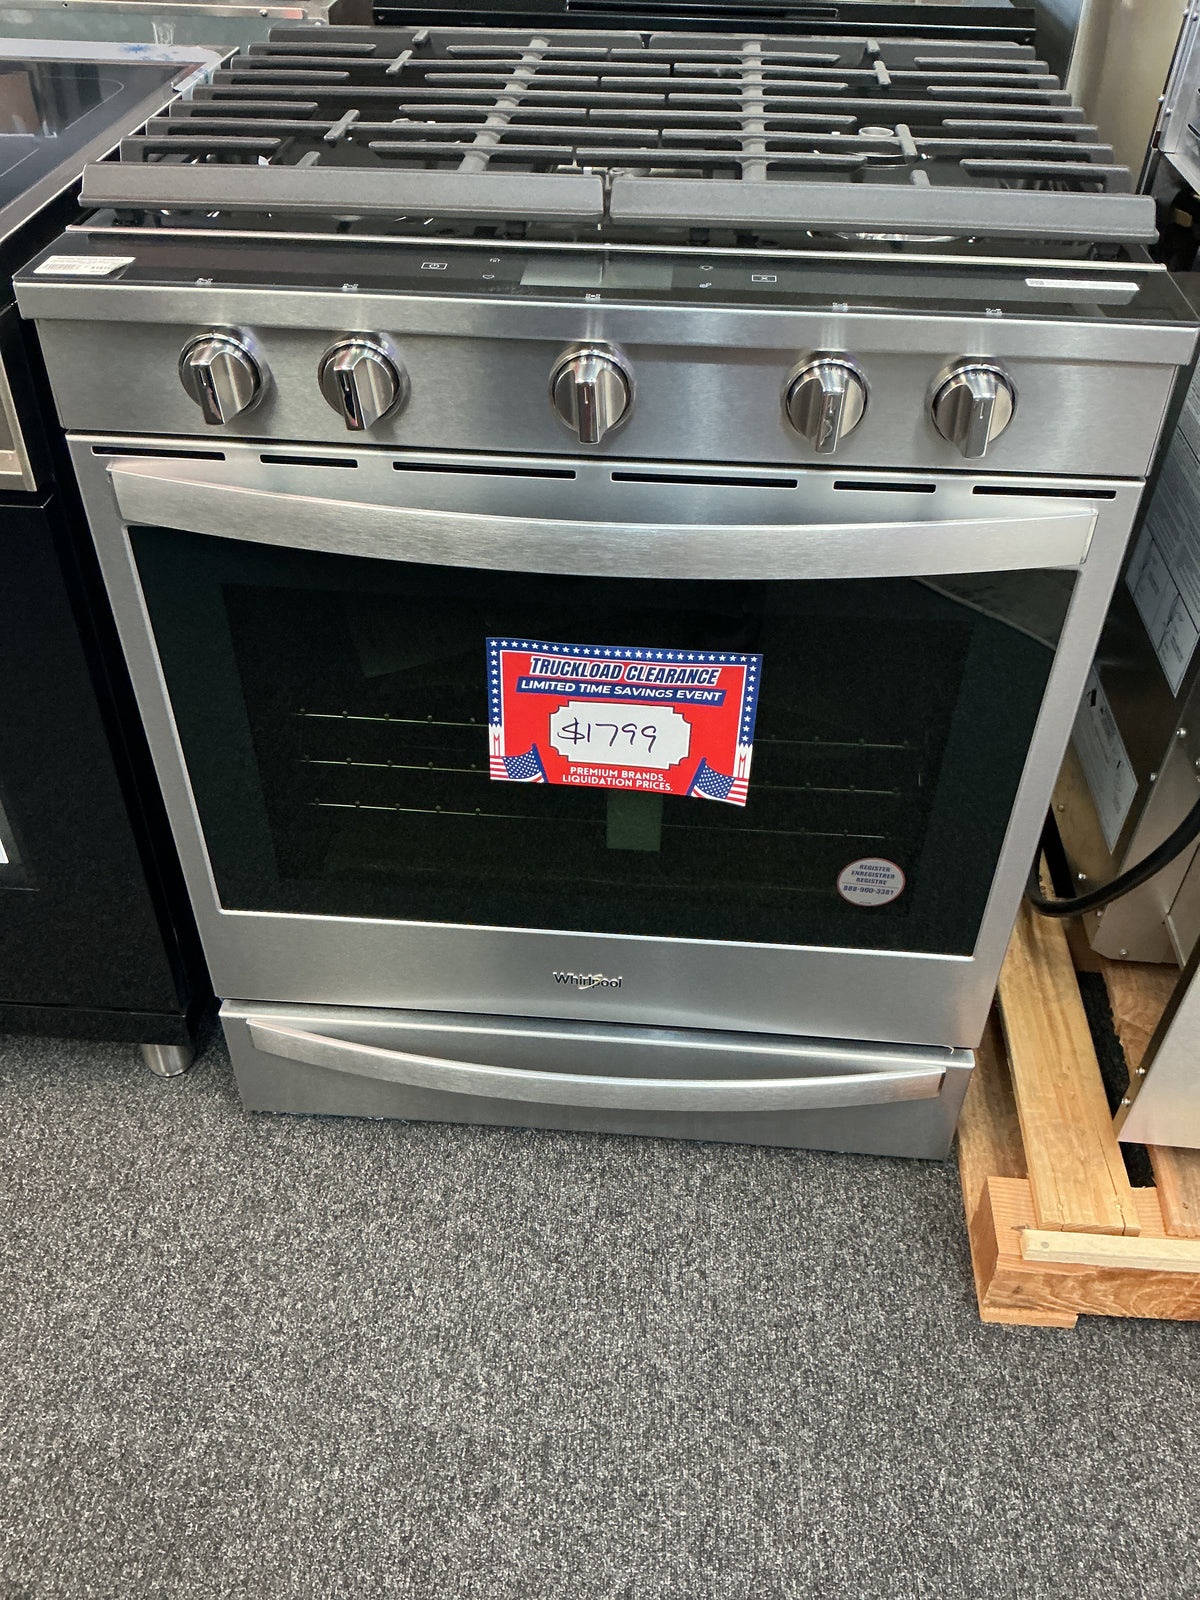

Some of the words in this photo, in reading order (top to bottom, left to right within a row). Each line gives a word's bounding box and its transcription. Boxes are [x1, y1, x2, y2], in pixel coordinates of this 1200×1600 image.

[530, 657, 623, 680] TRUCKLOAD
[625, 666, 720, 686] CLEARANCE
[521, 679, 576, 693] LIMITED
[579, 684, 612, 695] TIME
[614, 686, 673, 698] SAVINGS
[676, 690, 722, 702] EVENT
[557, 717, 657, 753] $1799
[562, 775, 634, 788] LIQUIDATION
[636, 780, 674, 792] PRICES.
[570, 766, 619, 779] PREMIUM
[621, 770, 667, 782] BRANDS.
[552, 971, 623, 989] Whirlpool
